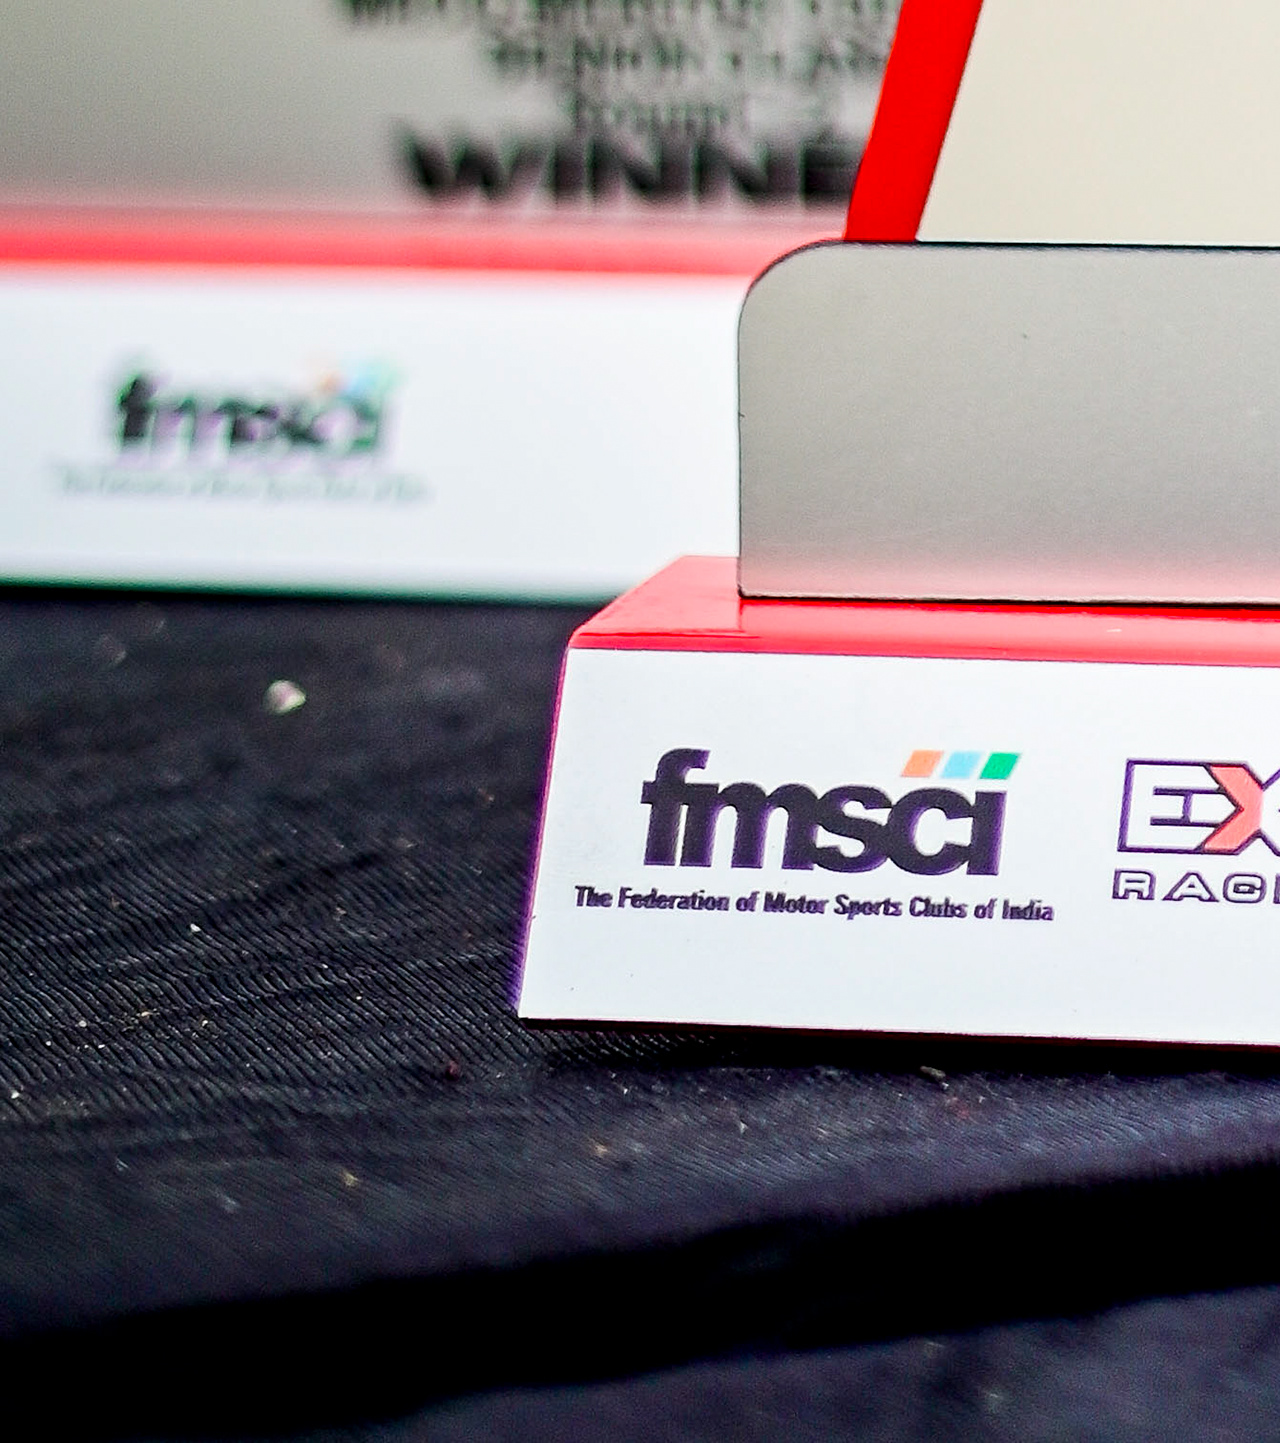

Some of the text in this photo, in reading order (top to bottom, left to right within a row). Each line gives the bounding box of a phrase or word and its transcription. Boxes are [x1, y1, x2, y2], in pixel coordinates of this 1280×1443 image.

[640, 747, 1010, 877] fmsci
[574, 884, 1054, 922] The Federation of Motor Sports Clubs of India
